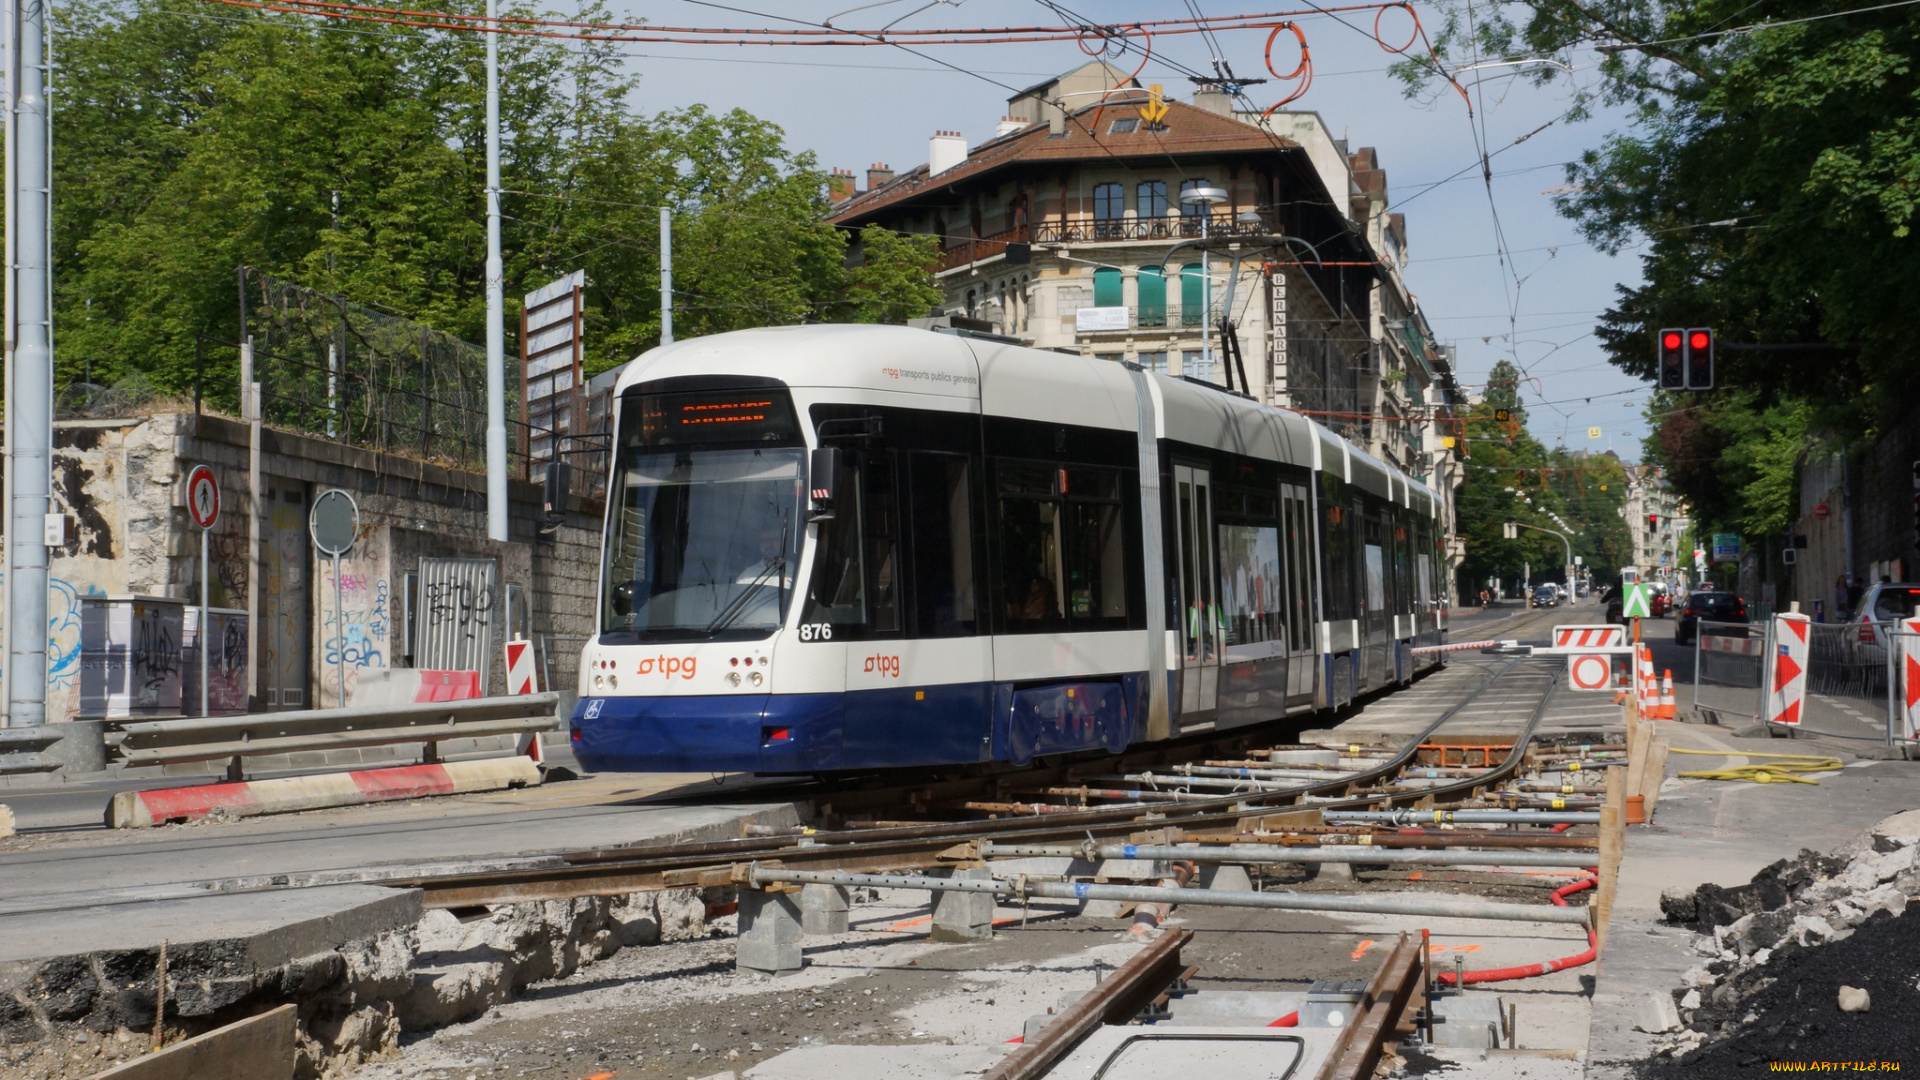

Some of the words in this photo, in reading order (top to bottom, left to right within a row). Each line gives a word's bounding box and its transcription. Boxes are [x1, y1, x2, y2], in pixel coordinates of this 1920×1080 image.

[1275, 275, 1285, 363] BERNARD
[900, 369, 930, 380] transports
[931, 372, 951, 382] publics
[953, 375, 977, 385] genevois
[1497, 410, 1508, 420] 40
[800, 623, 832, 640] 876
